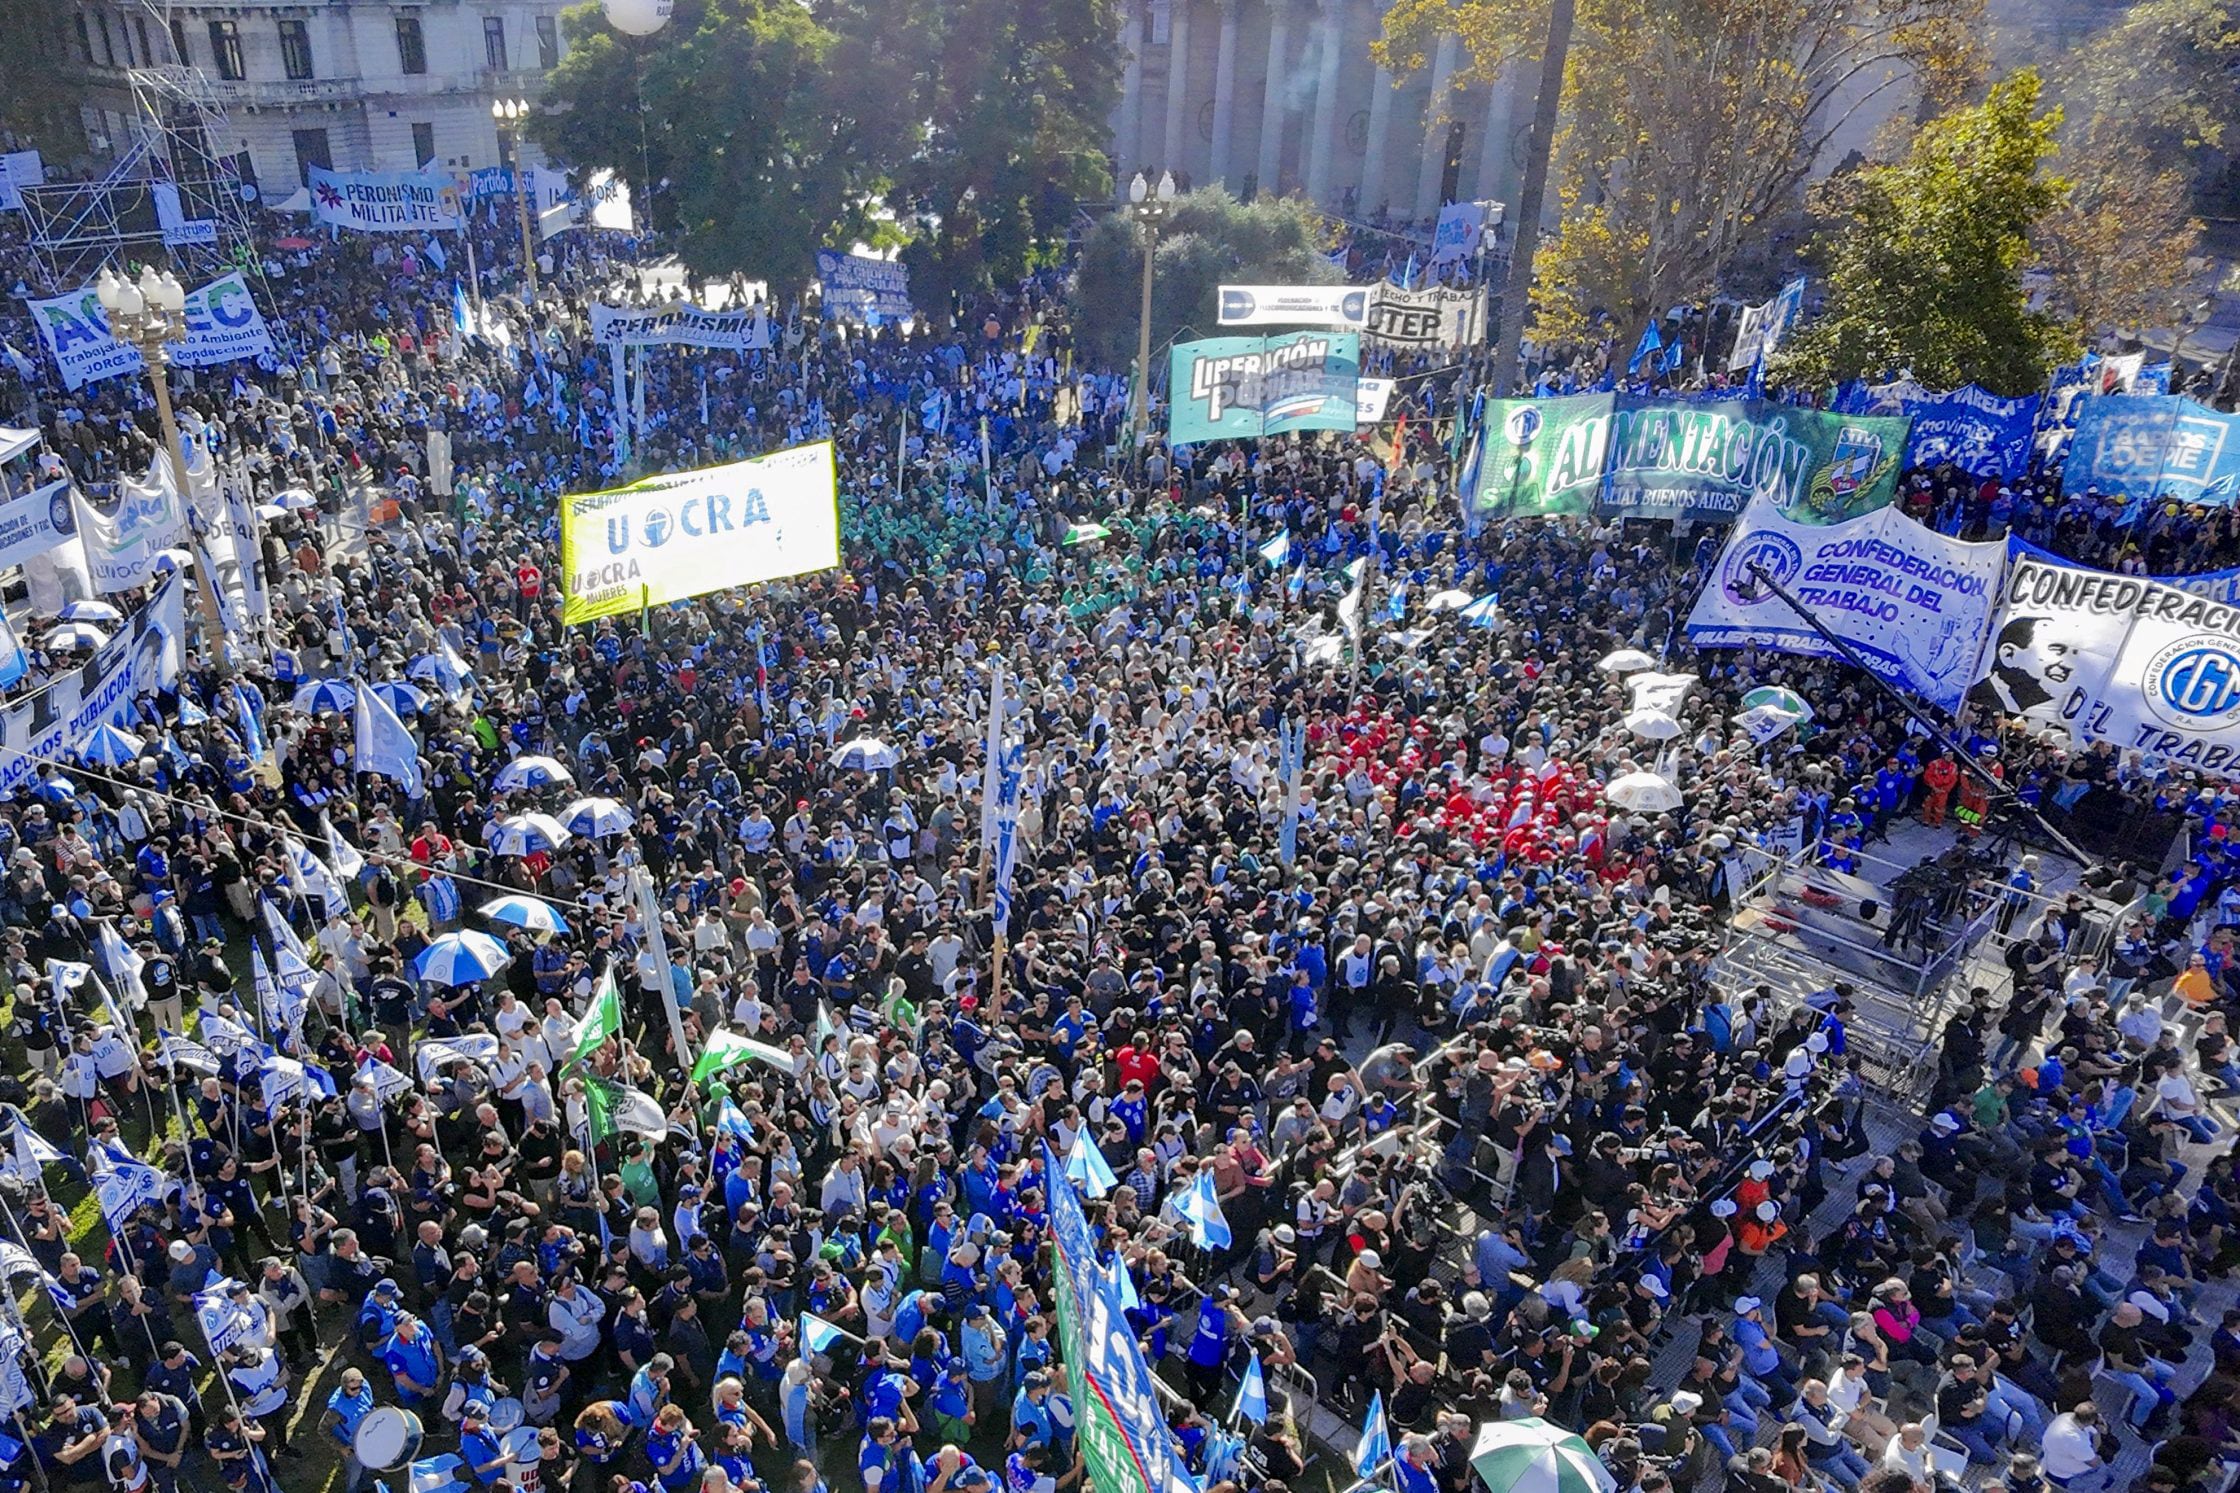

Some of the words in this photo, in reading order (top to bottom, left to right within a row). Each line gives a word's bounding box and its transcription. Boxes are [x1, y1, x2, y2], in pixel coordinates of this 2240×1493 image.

[345, 183, 434, 204] PERONISMO
[471, 169, 508, 196] Partido
[350, 203, 439, 223] MILITANTE
[1417, 295, 1424, 303] Y
[611, 311, 756, 334] PERONISMO
[200, 328, 263, 345] Ambiente
[1191, 336, 1328, 400] LIBERACIÓN
[1953, 386, 2016, 416] VARELA
[1549, 408, 1808, 510] ALIMENTACIÓN
[2113, 446, 2155, 467] DE
[2164, 447, 2199, 470] PIE
[1643, 488, 1696, 509] BUENOS
[1700, 491, 1742, 513] AIRES
[1815, 538, 1989, 597] CONFEDERACIÓN
[586, 585, 627, 605] MUJERES
[1803, 563, 1904, 598] GENERAL
[1905, 583, 1943, 613] DEL
[2009, 563, 2240, 639] CONFEDERACI
[1797, 586, 1899, 623] TRABAJO
[1692, 630, 1775, 646] MUJERES
[69, 660, 134, 737] PUBLICOS
[2062, 685, 2114, 735] DEL
